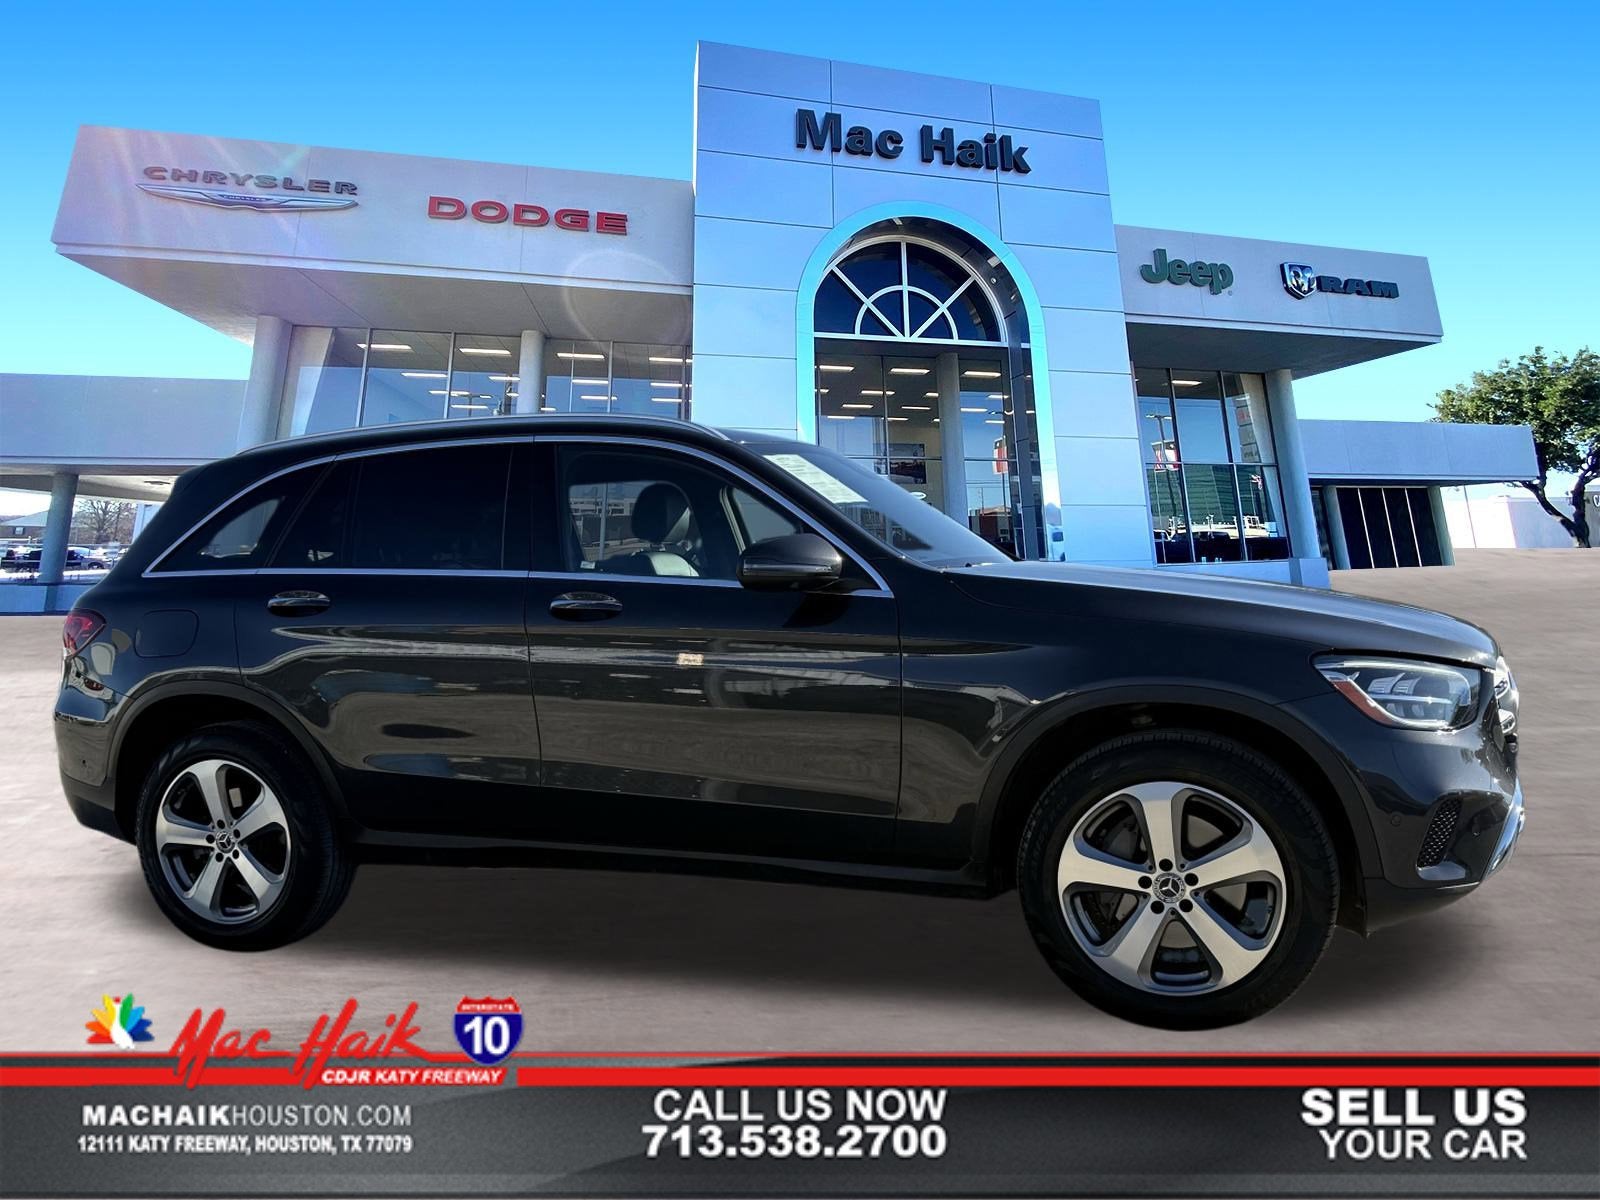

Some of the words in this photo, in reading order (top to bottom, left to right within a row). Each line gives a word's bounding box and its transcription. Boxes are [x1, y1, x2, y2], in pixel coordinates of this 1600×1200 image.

[795, 109, 903, 159] Mac
[920, 124, 1031, 174] Haik
[143, 166, 359, 196] CHRYSLER
[428, 196, 628, 236] DODGE
[1140, 248, 1234, 296] Jeep
[1316, 275, 1399, 299] RAM
